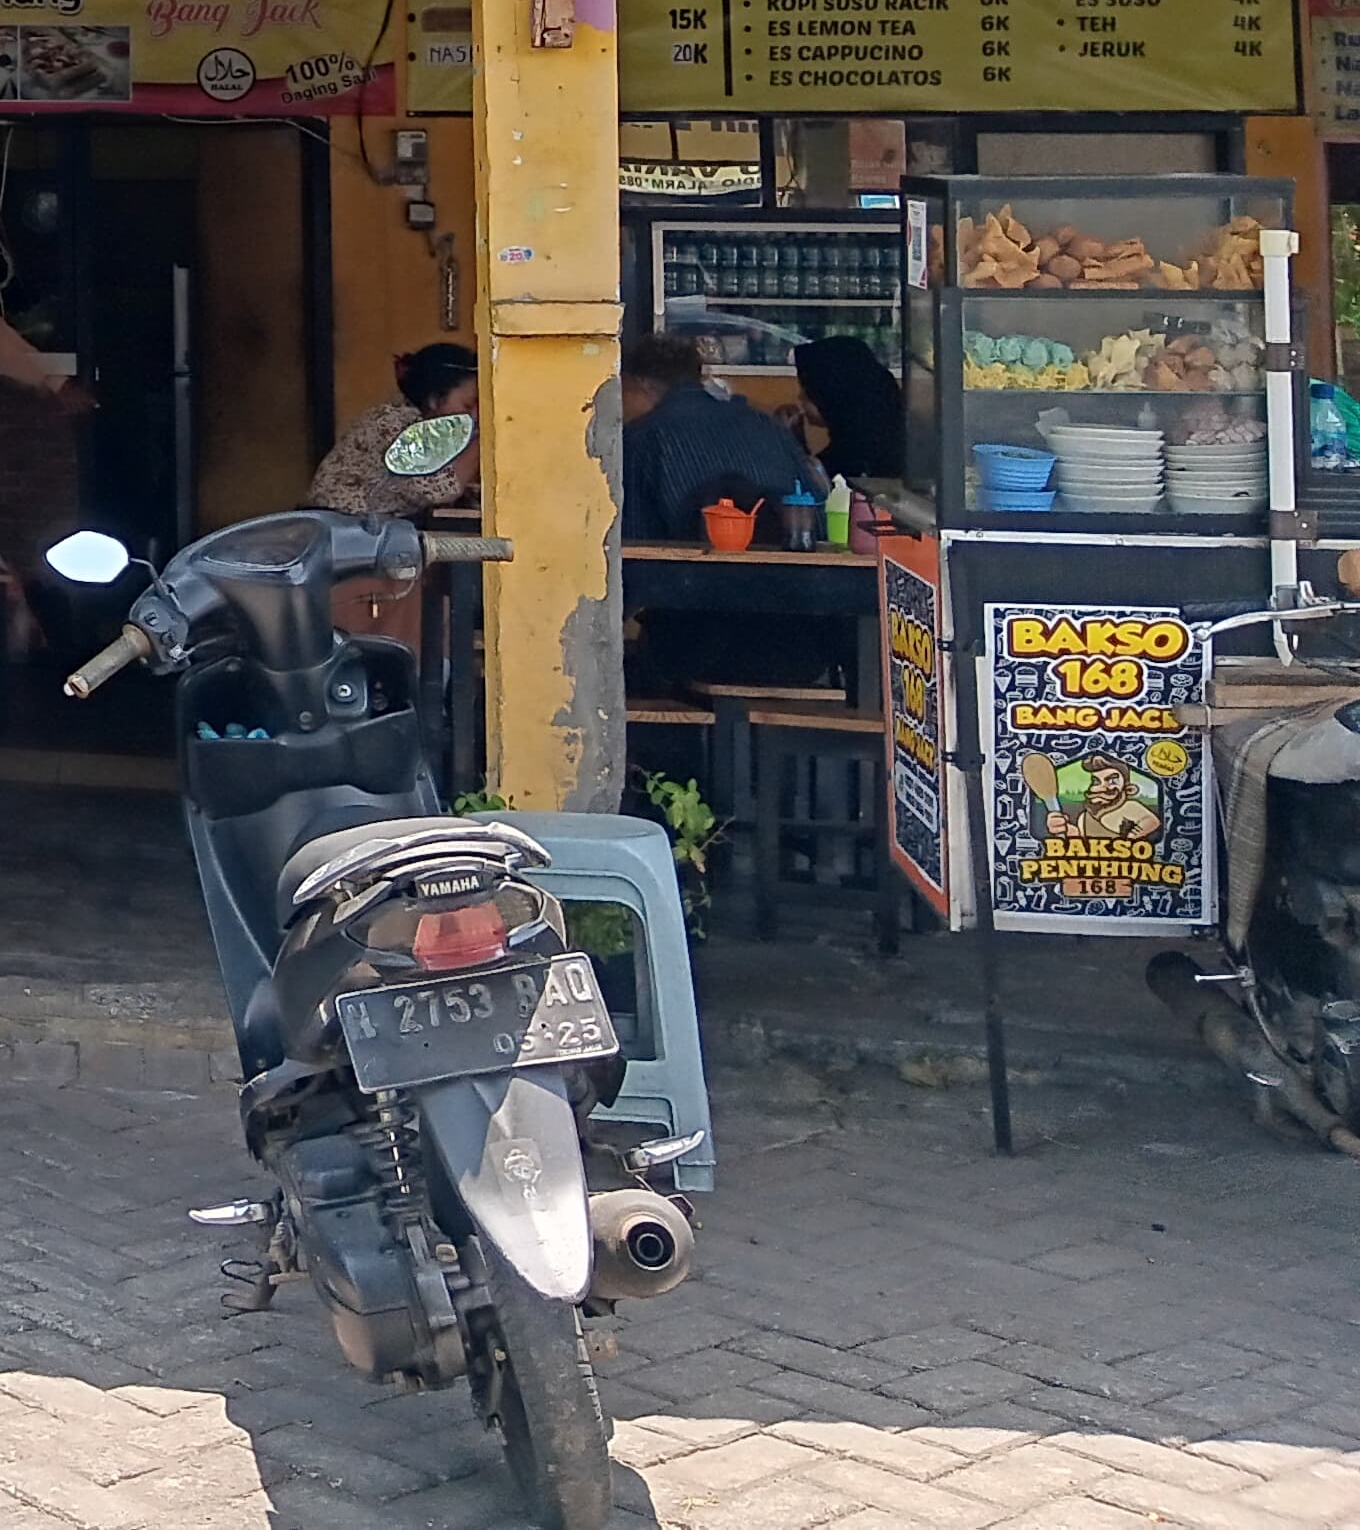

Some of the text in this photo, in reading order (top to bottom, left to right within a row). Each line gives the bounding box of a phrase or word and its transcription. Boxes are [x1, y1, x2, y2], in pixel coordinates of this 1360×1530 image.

[669, 9, 707, 29] 15K
[768, 20, 916, 36] ES LEMON TEA
[1077, 17, 1116, 32] TEH
[769, 45, 923, 61] ES CAPPUCINO
[1078, 41, 1145, 58] JERUK
[285, 51, 355, 84] 100%
[769, 70, 942, 86] ES CHOCOLATOS
[281, 81, 338, 105] Daging
[1008, 618, 1192, 661] BAKSO
[1052, 658, 1144, 700] 168
[1010, 705, 1100, 732] BANG
[1043, 837, 1154, 861] BAKSO
[1019, 858, 1186, 886] PENTHUNG
[420, 874, 482, 898] YAMAHA
[1078, 879, 1118, 896] 168
[393, 983, 494, 1034] 2753
